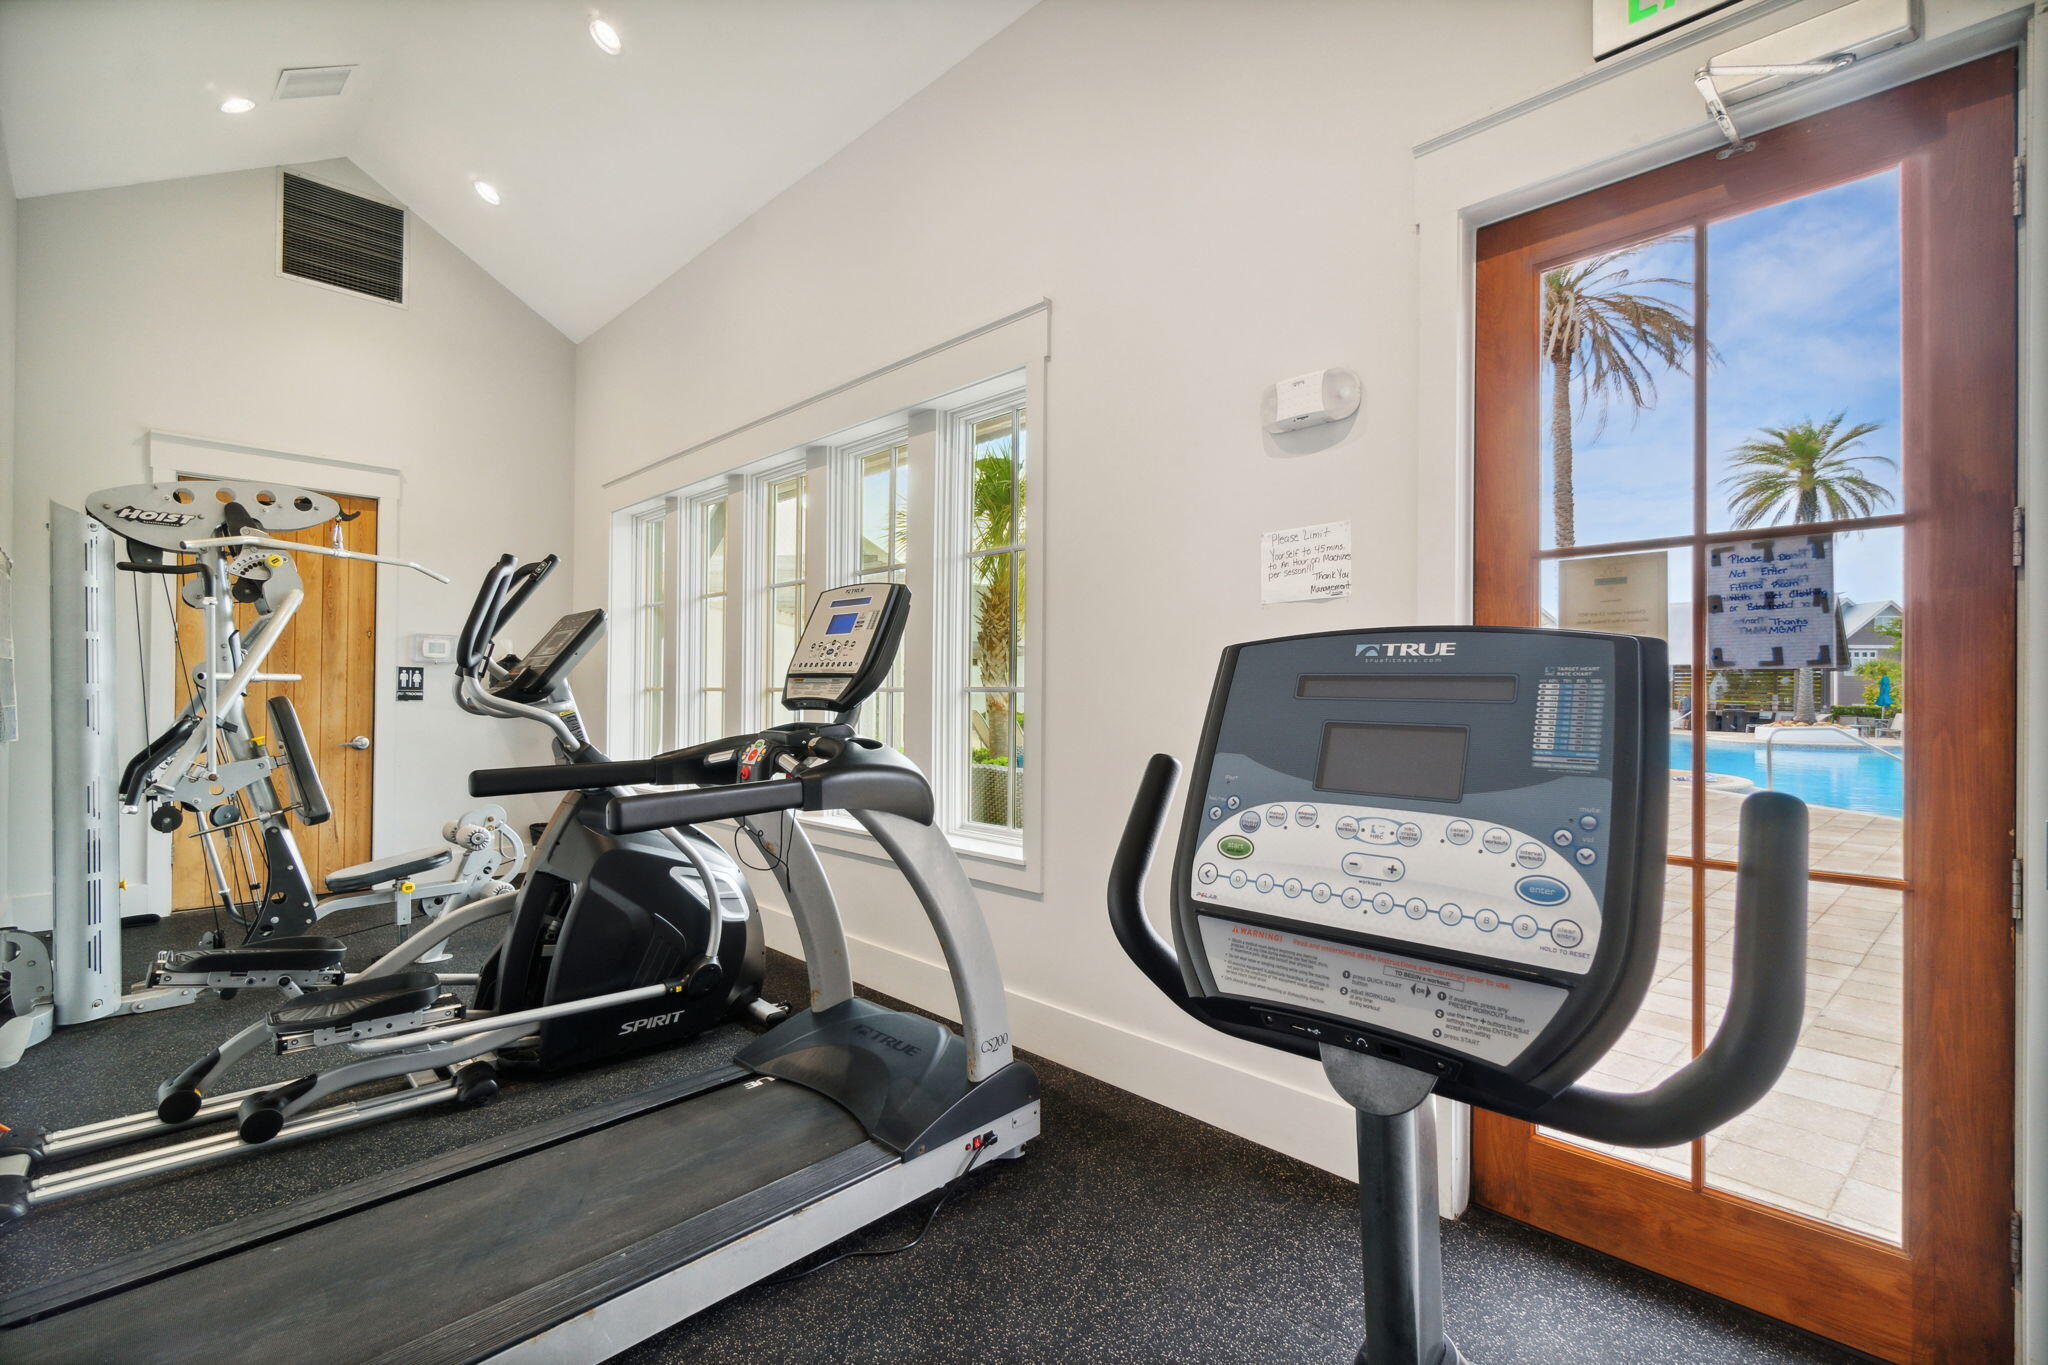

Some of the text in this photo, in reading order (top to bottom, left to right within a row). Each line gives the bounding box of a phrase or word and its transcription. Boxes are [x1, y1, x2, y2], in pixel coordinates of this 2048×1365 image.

[119, 508, 196, 524] HOIST
[1271, 527, 1331, 547] Please Limit
[1302, 547, 1311, 557] to
[1314, 544, 1325, 553] 45
[1268, 562, 1277, 571] to
[1310, 557, 1320, 565] on
[1323, 553, 1351, 563] Machines
[1728, 554, 1762, 564] Please
[1268, 572, 1280, 582] per
[1312, 568, 1349, 581] Thank You
[1729, 567, 1788, 579] Not Enter
[1310, 581, 1351, 595] Management
[1730, 583, 1764, 592] Fitness
[1729, 604, 1739, 612] or
[1768, 618, 1808, 626] Thanks
[1382, 643, 1457, 657] TRUE
[1228, 842, 1244, 850] start
[1529, 886, 1556, 895] enter
[1557, 927, 1575, 935] clear
[1241, 927, 1283, 942] WARNING!
[1366, 953, 1377, 961] the
[1378, 955, 1418, 972] instructions
[1419, 963, 1432, 973] and
[1433, 967, 1465, 982] warnings
[1539, 945, 1558, 953] HOLD
[1569, 950, 1591, 959] RESET
[1394, 969, 1403, 977] TO
[1403, 972, 1422, 981] BEGIN
[1366, 976, 1384, 985] QUICK
[1384, 979, 1402, 988] START
[1364, 991, 1396, 1003] WORKLOAD
[1448, 1001, 1471, 1011] PRESET
[1472, 1006, 1503, 1018] WORKOUT
[1480, 1002, 1496, 1010] press
[617, 1009, 685, 1036] SPIRIT
[1492, 1027, 1512, 1037] ENTER
[871, 1031, 922, 1057] TRUE
[980, 1032, 1009, 1054] CS200
